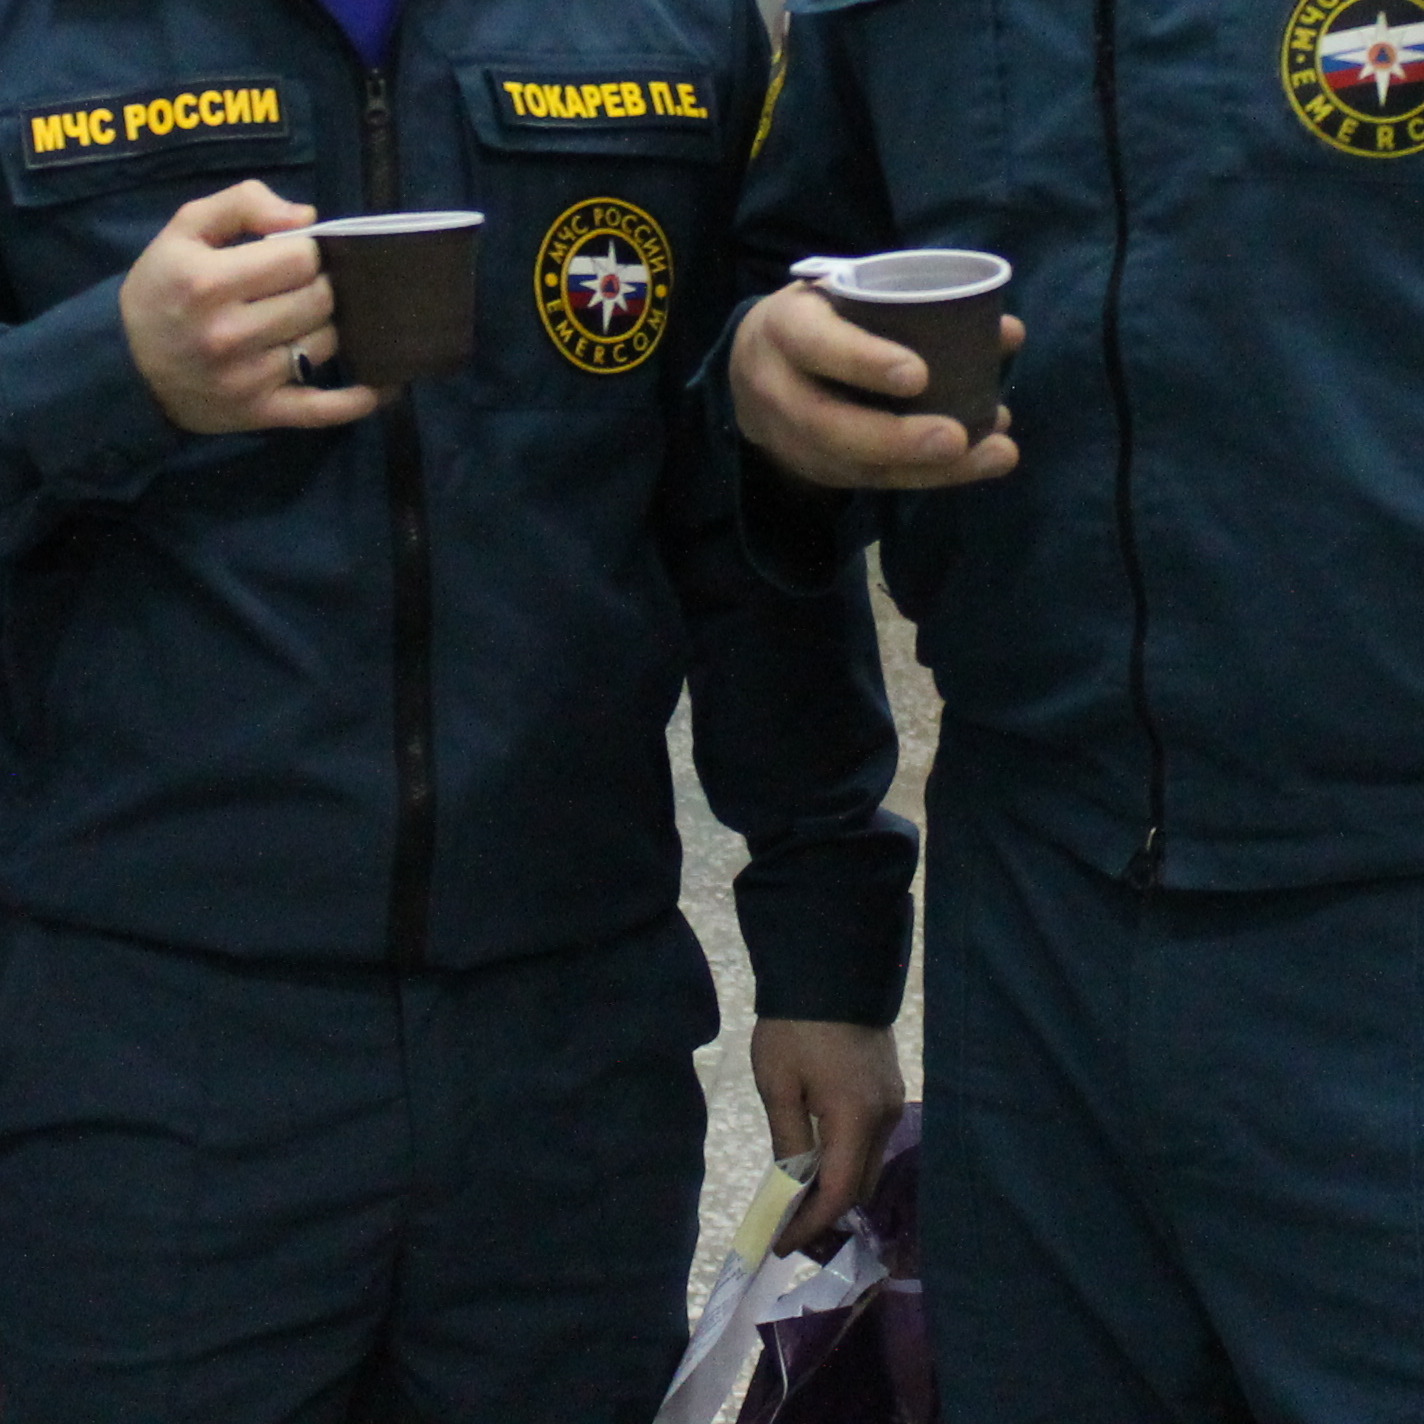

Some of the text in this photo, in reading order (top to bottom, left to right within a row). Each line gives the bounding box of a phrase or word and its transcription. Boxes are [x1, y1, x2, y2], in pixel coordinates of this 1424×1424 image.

[31, 87, 281, 154] МЧС РОССИИ
[502, 80, 709, 119] ТОКАРЕВ П.Е.
[548, 206, 668, 275] МЧС РОССИИ
[546, 298, 666, 365] EMERCOM
